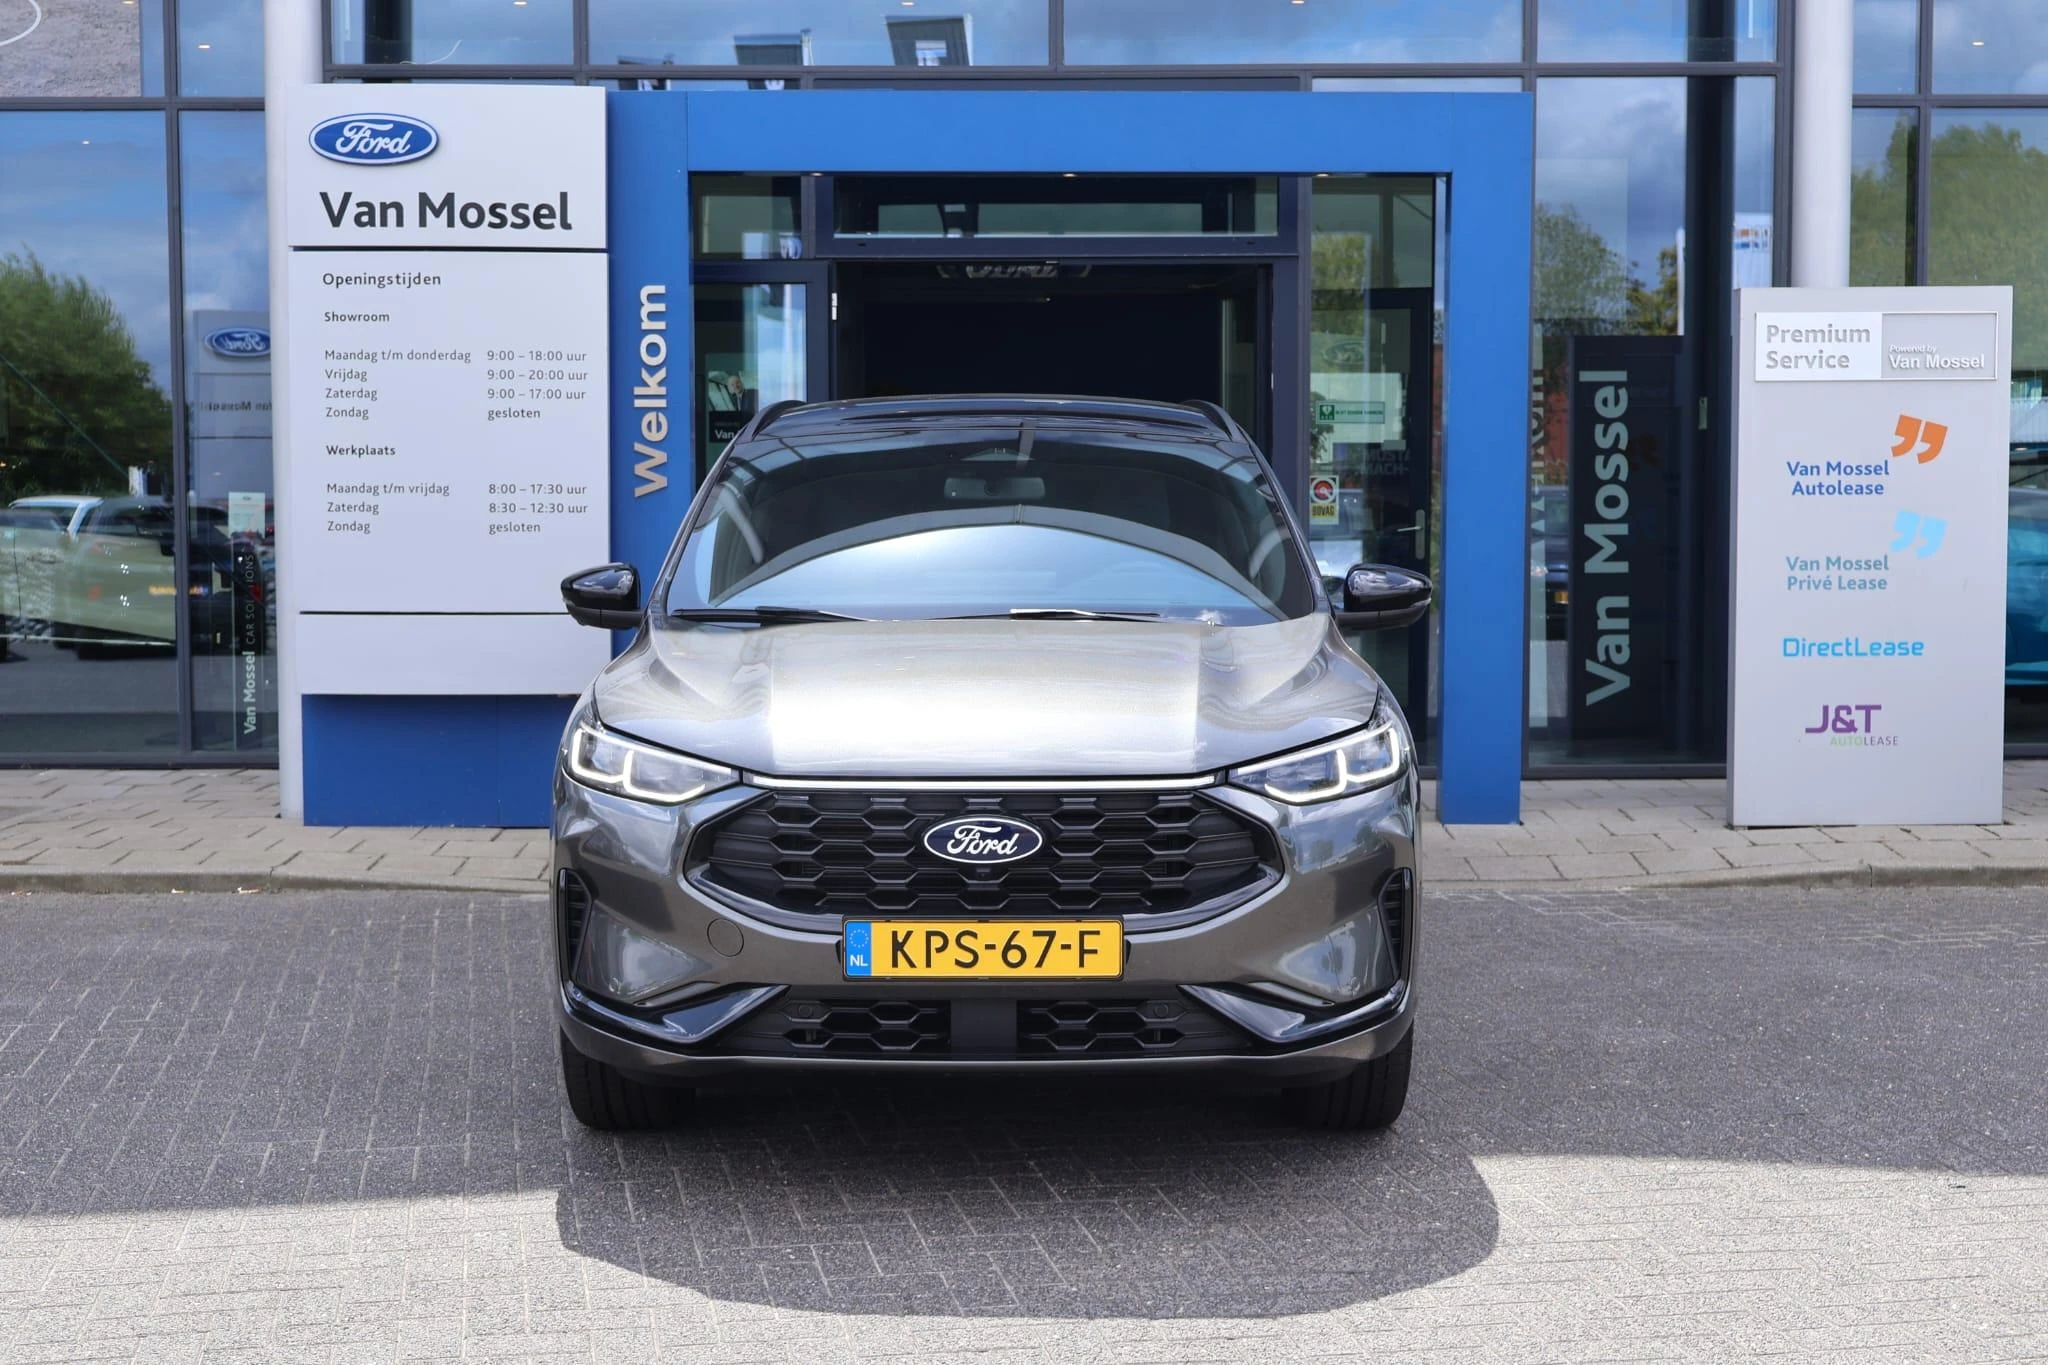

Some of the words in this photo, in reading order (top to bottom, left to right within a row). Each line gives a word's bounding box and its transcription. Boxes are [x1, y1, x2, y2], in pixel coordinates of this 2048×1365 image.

[335, 121, 413, 154] Ford
[319, 191, 405, 228] Van
[418, 191, 573, 231] Mossel
[322, 272, 442, 289] Openingstijden
[324, 311, 391, 323] Showroom
[1766, 324, 1871, 344] Premium
[487, 350, 515, 361] 9:00
[529, 350, 563, 361] 18:00
[566, 353, 587, 362] uur
[1890, 344, 1925, 354] Powered
[325, 350, 378, 364] Maandag
[381, 350, 404, 361] t/m
[406, 350, 472, 364] donderdag
[1765, 350, 1851, 370] Service
[1889, 354, 1921, 370] Van
[1925, 353, 1985, 370] Mossel
[325, 369, 368, 382] Vrijdag
[487, 369, 515, 380] 9:00
[528, 369, 565, 381] 20:00
[567, 372, 588, 381] uur
[325, 388, 378, 402] Zaterdag
[487, 388, 516, 400] 9:00
[529, 388, 562, 400] 17:00
[566, 391, 587, 400] uur
[633, 284, 668, 497] Welkom
[325, 407, 369, 420] Zondag
[487, 407, 541, 421] gesloten
[326, 445, 396, 458] Werkplaats
[1578, 369, 1631, 575] Mossel
[1786, 461, 1821, 477] Van
[1826, 460, 1890, 477] Mossel
[326, 483, 380, 497] Maandag
[383, 483, 405, 494] t/m
[408, 483, 450, 497] vrijdag
[488, 484, 517, 495] 8:00
[530, 484, 563, 495] 17:30
[566, 487, 587, 495] uur
[1791, 480, 1885, 497] Autolease
[327, 502, 380, 516] Zaterdag
[488, 503, 517, 514] 8:30
[530, 503, 564, 514] 12:30
[567, 506, 588, 514] uur
[327, 521, 371, 535] Zondag
[488, 522, 541, 535] gesloten
[1785, 556, 1821, 571] Van
[1825, 555, 1889, 571] Mossel
[1787, 575, 1833, 591] Privé
[1837, 575, 1888, 591] Lease
[1585, 595, 1632, 708] Van
[1783, 637, 1925, 657] DirectLease
[243, 651, 257, 703] Mossel
[244, 706, 258, 735] Van
[1804, 704, 1883, 734] J&T
[1830, 735, 1900, 747] AUTOLEASE
[946, 824, 1019, 856] Ford
[891, 930, 1101, 969] KPS-67-F
[850, 955, 868, 967] NL
